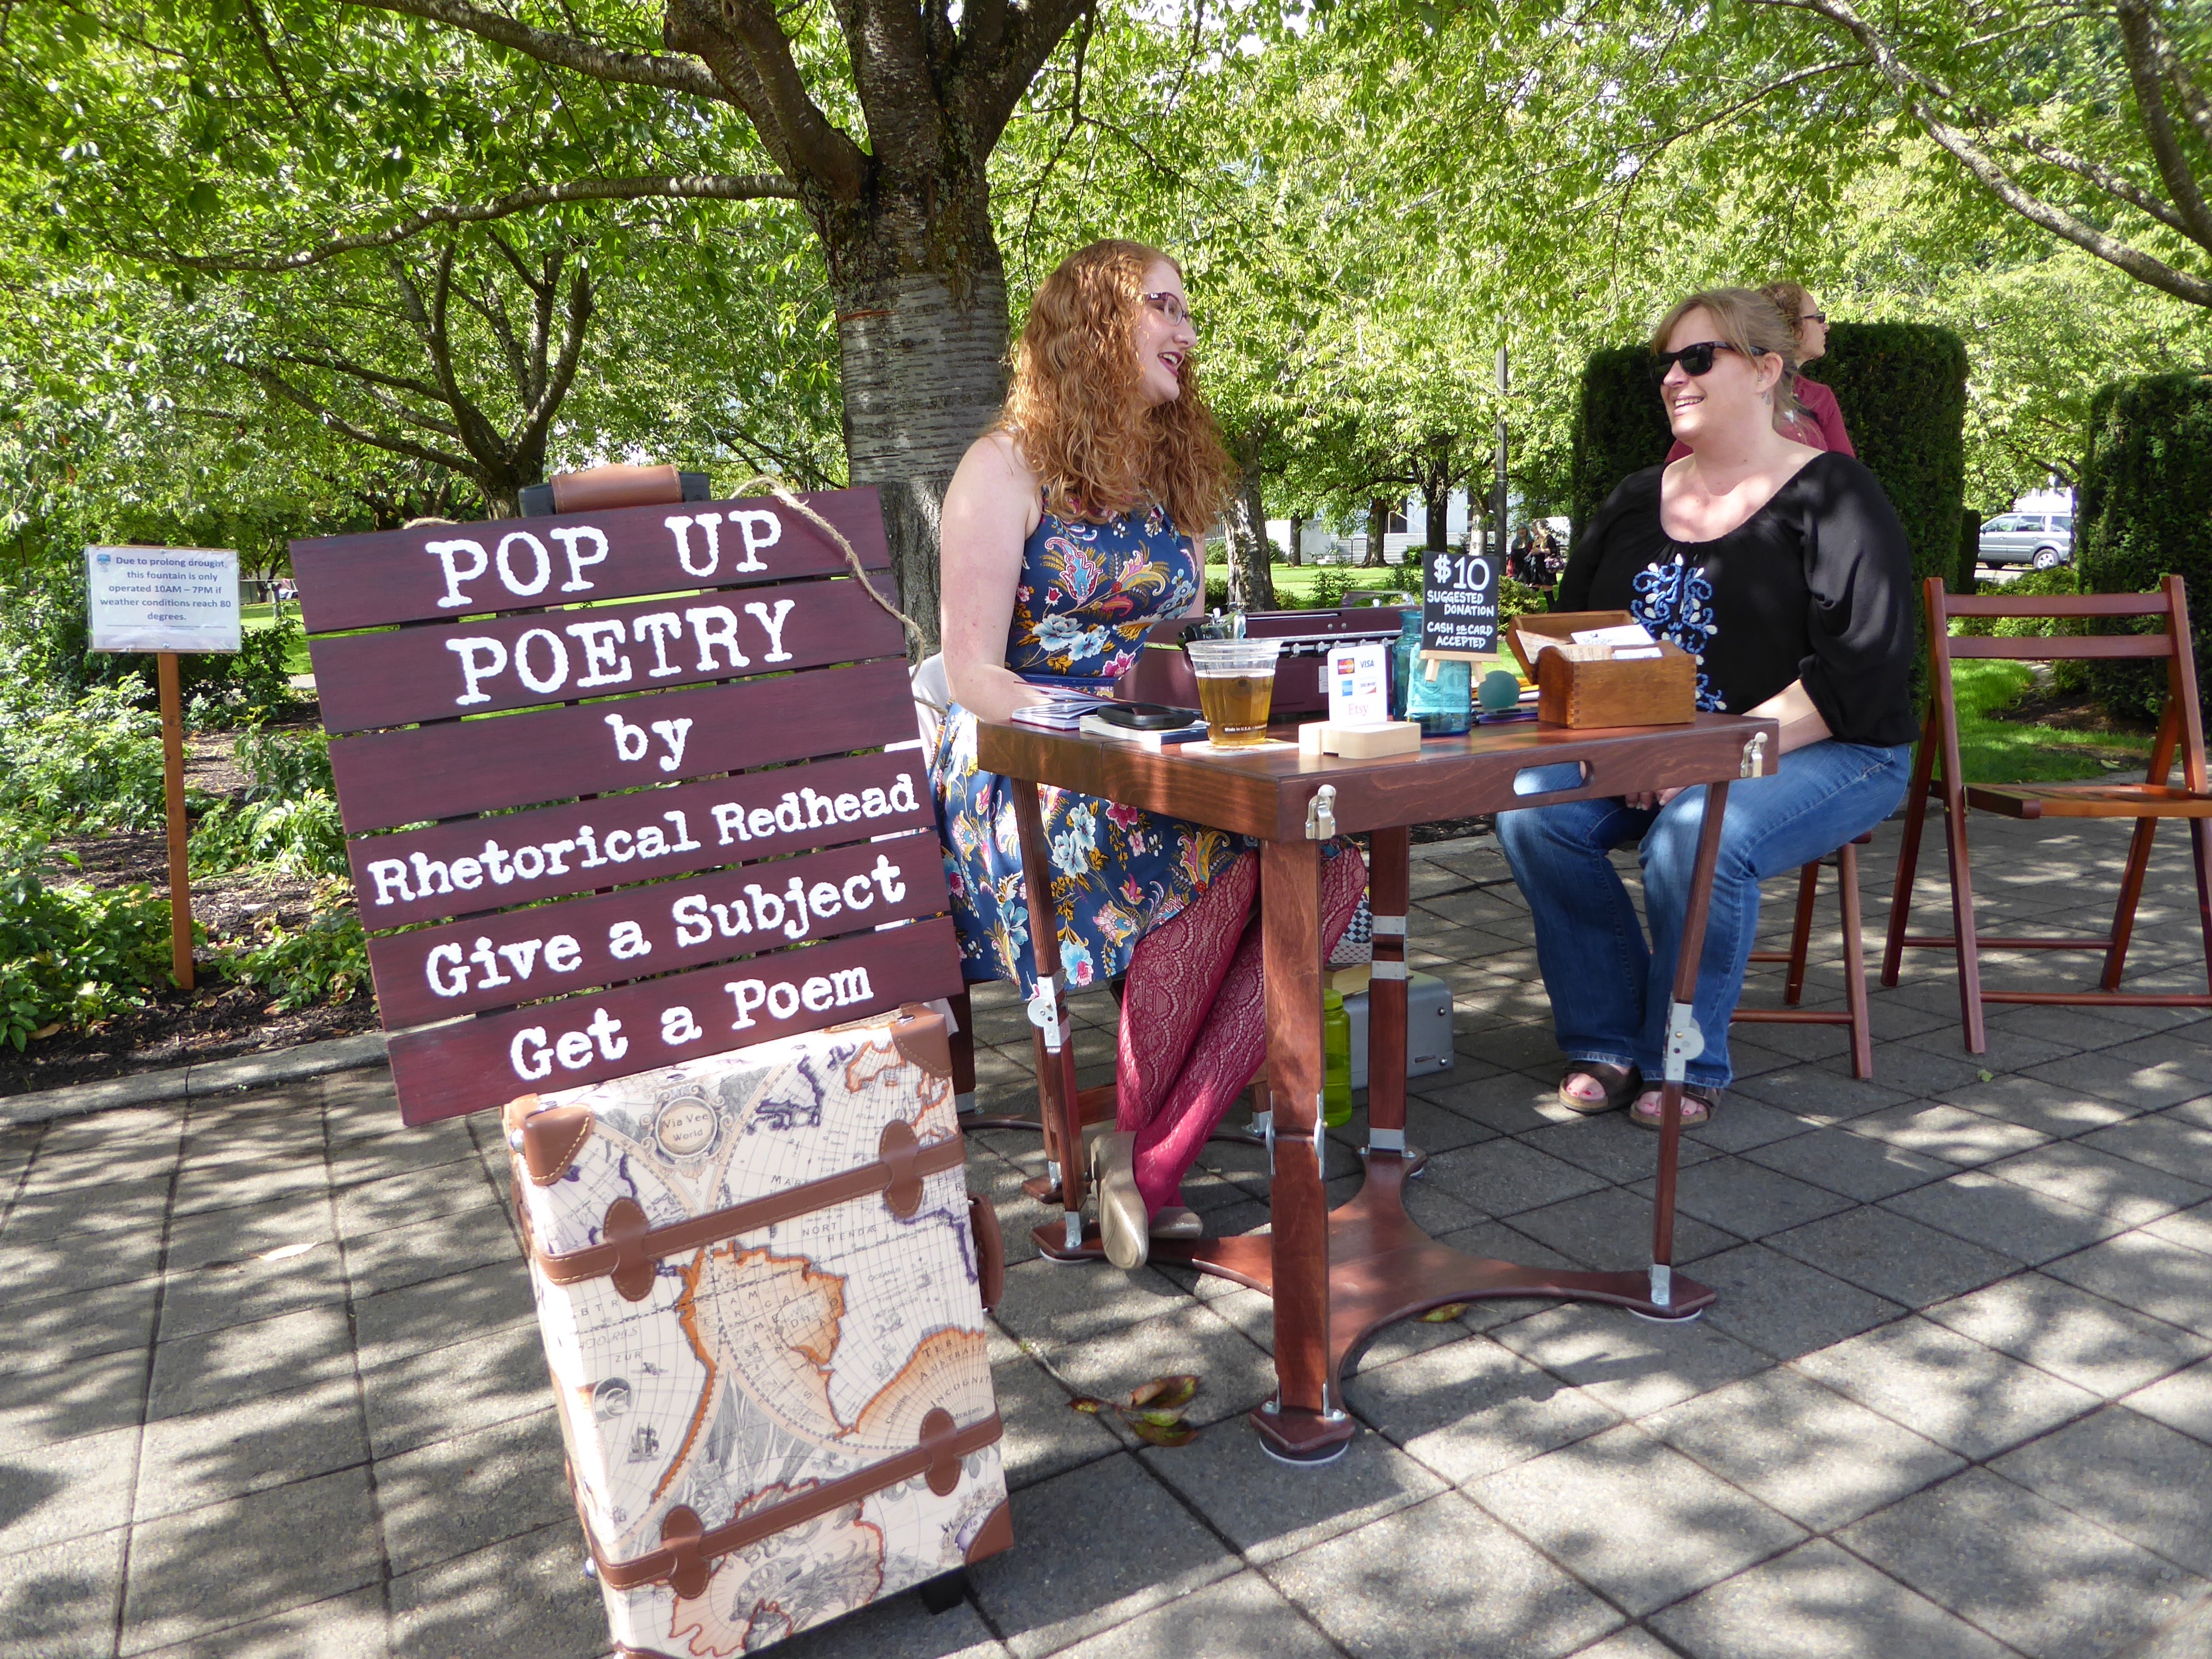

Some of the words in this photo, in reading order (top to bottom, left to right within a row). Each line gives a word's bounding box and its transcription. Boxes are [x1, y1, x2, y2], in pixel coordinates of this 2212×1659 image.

[150, 559, 186, 567] prolong
[425, 525, 609, 608] POP
[664, 510, 782, 577] UP
[147, 571, 186, 580] fountain
[198, 573, 218, 582] only
[1433, 553, 1490, 591] $10
[142, 598, 190, 607] conditions
[1427, 589, 1484, 604] SUGGESTED
[147, 612, 186, 621] degrees.
[1444, 603, 1494, 617] DONATION
[1427, 621, 1453, 633] CASH
[1467, 624, 1493, 636] CARD
[1435, 635, 1486, 649] ACCEPTED
[446, 599, 795, 706] POETRY
[1360, 660, 1375, 669] VISA
[1348, 703, 1369, 716] Etsy
[604, 713, 693, 771] by
[367, 810, 701, 905] Rhetorical
[711, 773, 920, 846] Redhead
[426, 935, 582, 997] Give
[609, 920, 652, 959] a
[672, 854, 906, 947] Subject
[510, 1008, 628, 1080] Get
[661, 1006, 703, 1045] a
[724, 967, 874, 1030] Poem
[663, 1119, 683, 1129] Via
[686, 1113, 708, 1123] Vee
[672, 1128, 703, 1141] World
